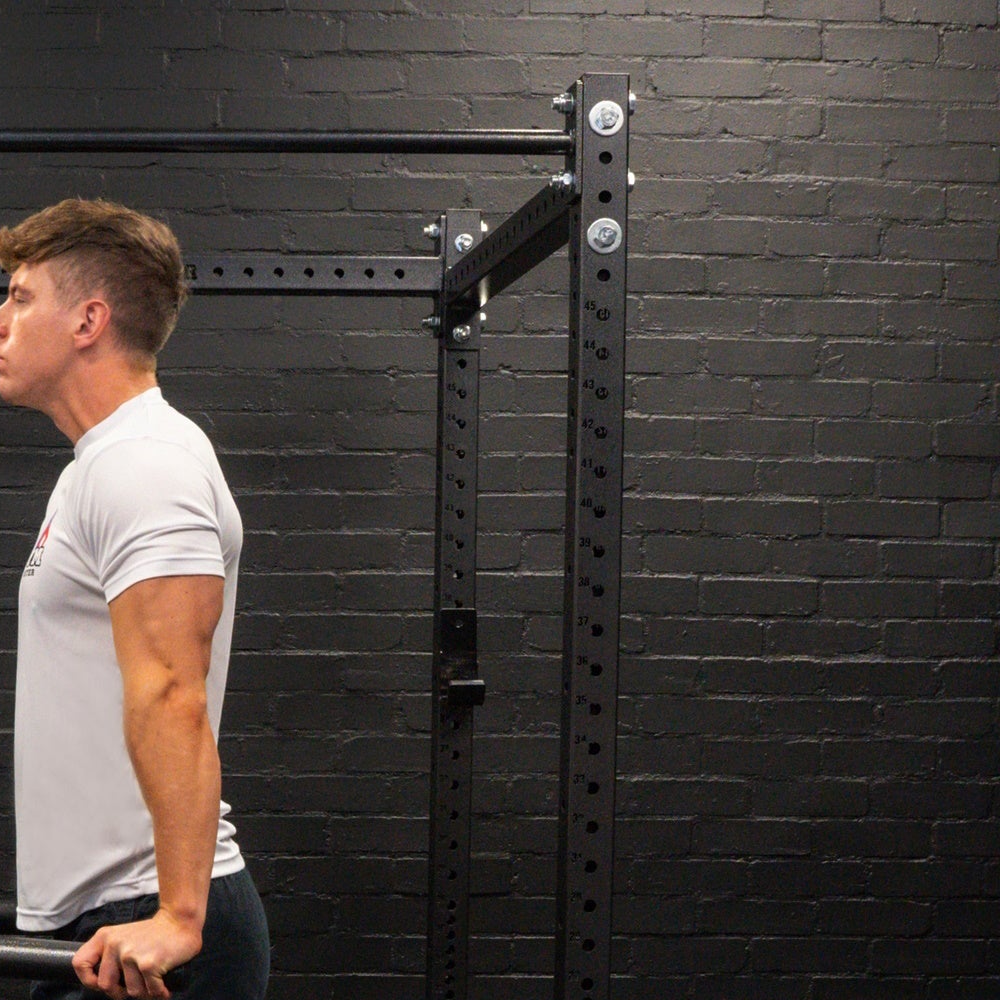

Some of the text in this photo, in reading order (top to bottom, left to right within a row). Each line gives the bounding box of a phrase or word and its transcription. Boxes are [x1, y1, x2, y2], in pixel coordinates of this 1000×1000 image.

[584, 301, 596, 310] 45
[583, 340, 596, 350] 44
[582, 379, 594, 389] 43
[581, 419, 593, 428] 42
[581, 458, 592, 468] 41
[580, 498, 592, 507] 40
[579, 537, 590, 547] 39
[578, 577, 589, 587] 38
[577, 616, 588, 626] 37
[576, 656, 587, 665] 36
